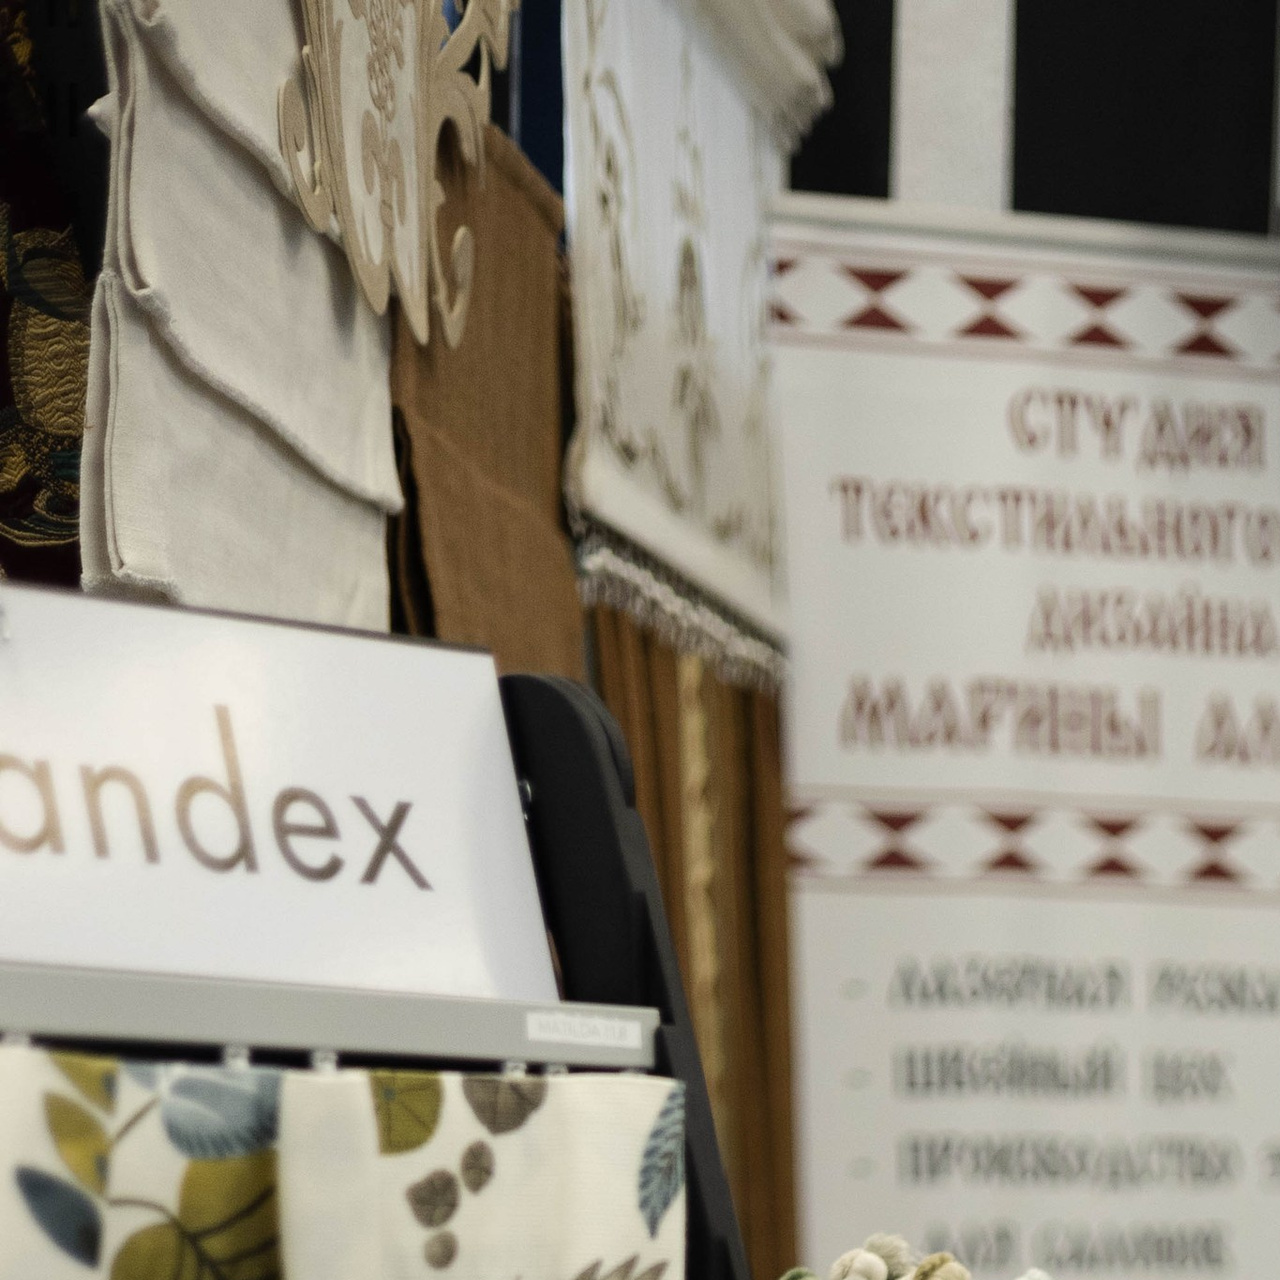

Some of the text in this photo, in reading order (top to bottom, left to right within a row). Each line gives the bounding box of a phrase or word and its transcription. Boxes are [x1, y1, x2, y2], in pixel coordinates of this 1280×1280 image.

[1008, 385, 1269, 470] СТУДИЯ
[1027, 584, 1280, 662] ДИЗАЙНА
[839, 676, 1161, 761] МАРИНЫ
